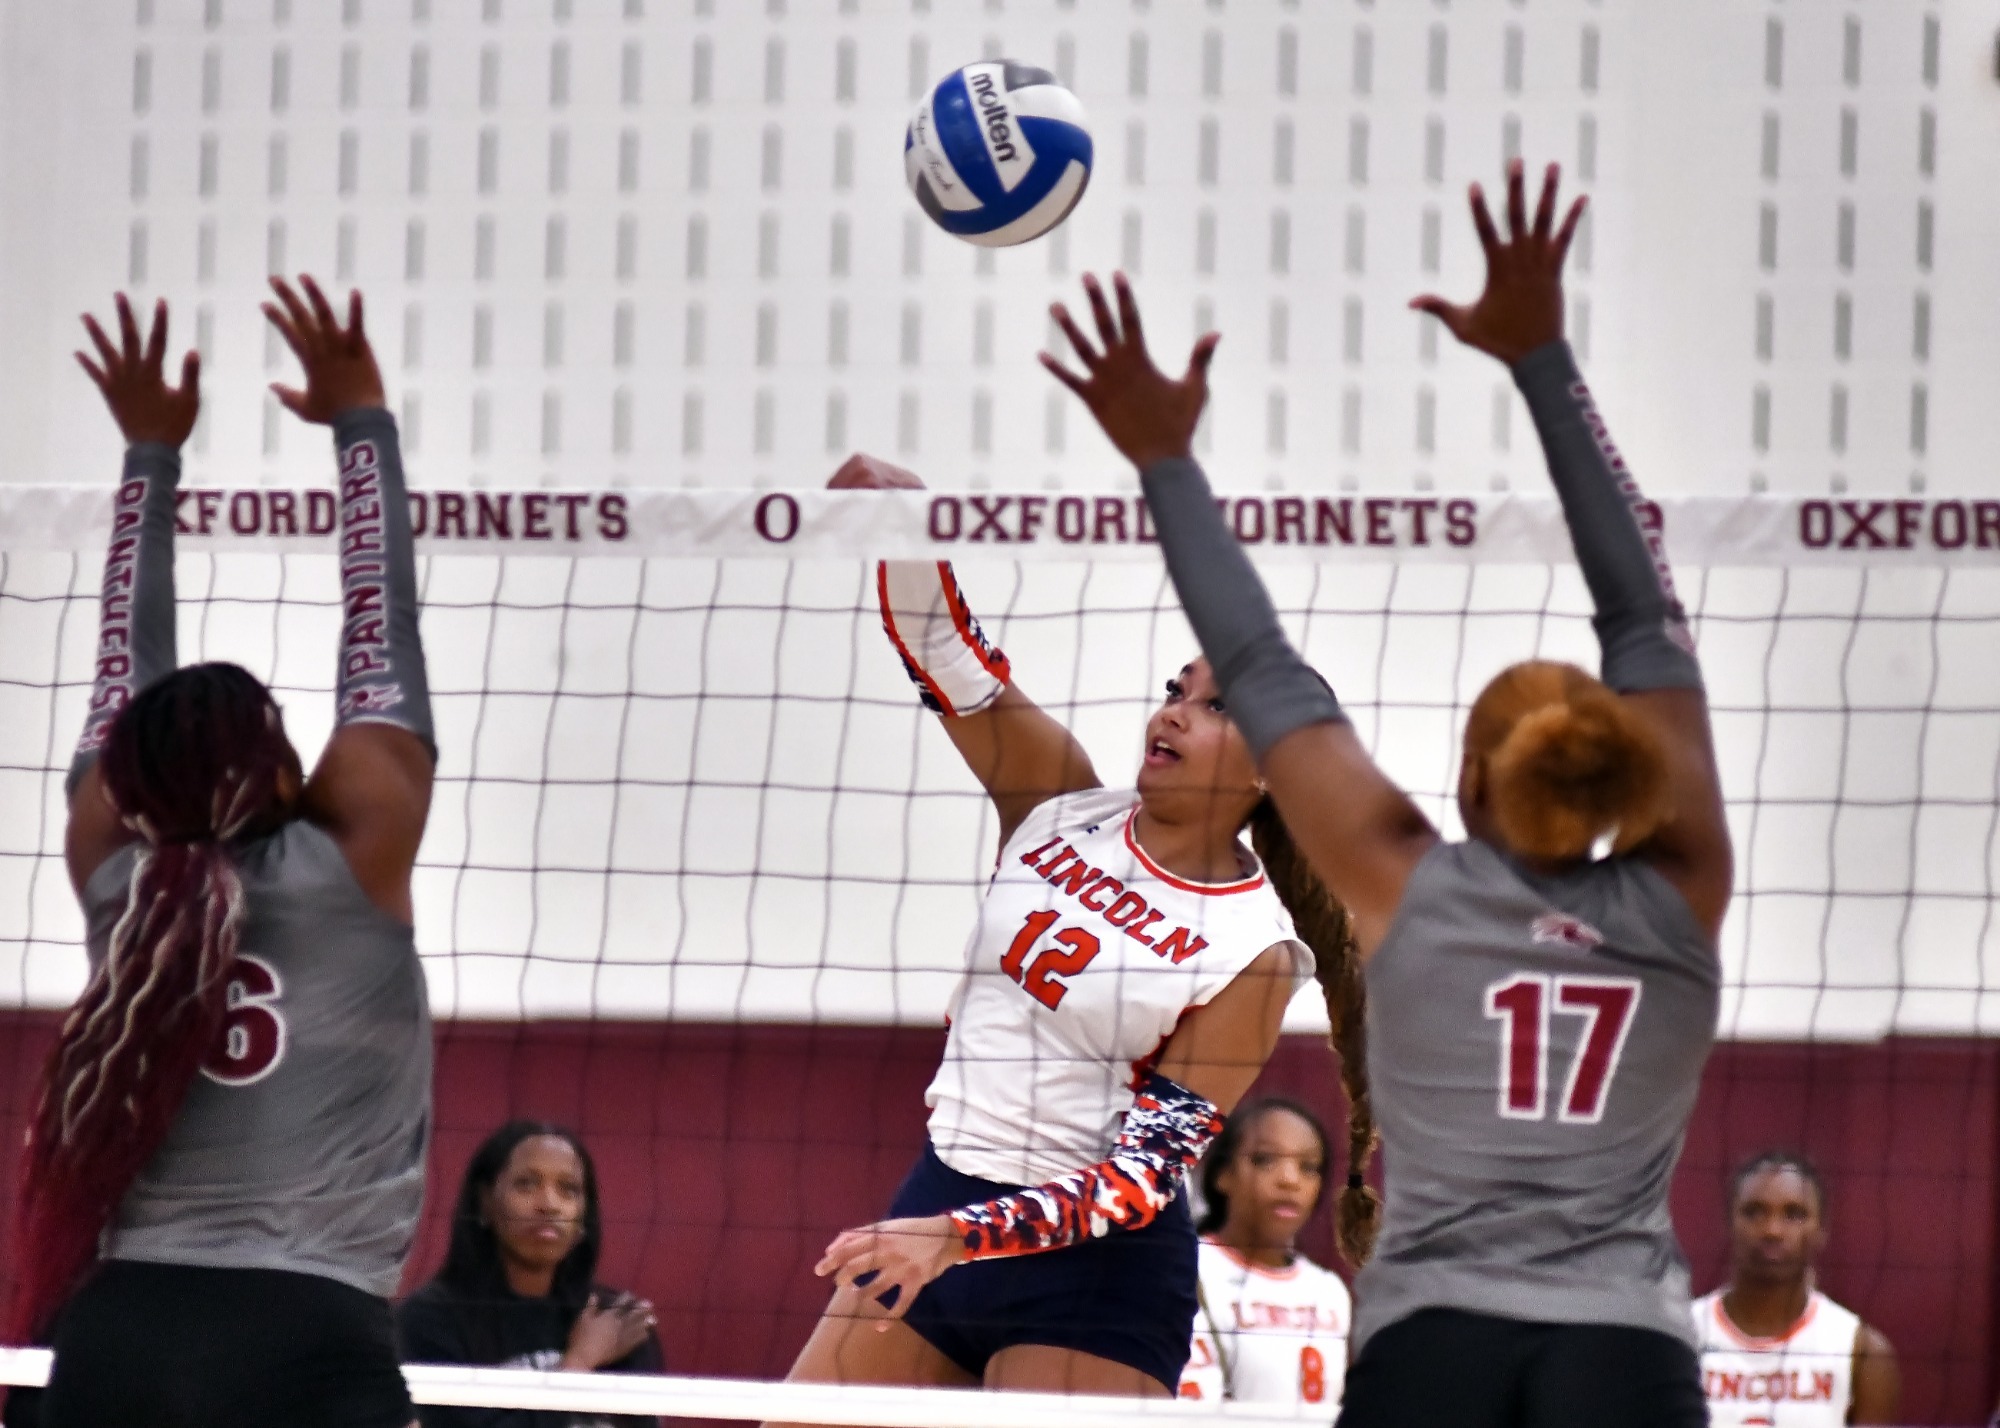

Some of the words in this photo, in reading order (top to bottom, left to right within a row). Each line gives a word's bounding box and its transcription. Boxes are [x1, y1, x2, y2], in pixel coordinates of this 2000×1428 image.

[970, 72, 1017, 162] molten
[340, 439, 389, 678] PANTHERS
[406, 490, 629, 542] ORNETS
[753, 491, 801, 543] O
[1217, 497, 1477, 547] ORNETS
[1018, 836, 1210, 966] LINCOLN
[1000, 909, 1101, 1012] 12
[200, 954, 287, 1087] 6
[1483, 971, 1643, 1125] 17
[1300, 1345, 1325, 1405] 8
[1706, 1370, 1834, 1403] INCOLN
